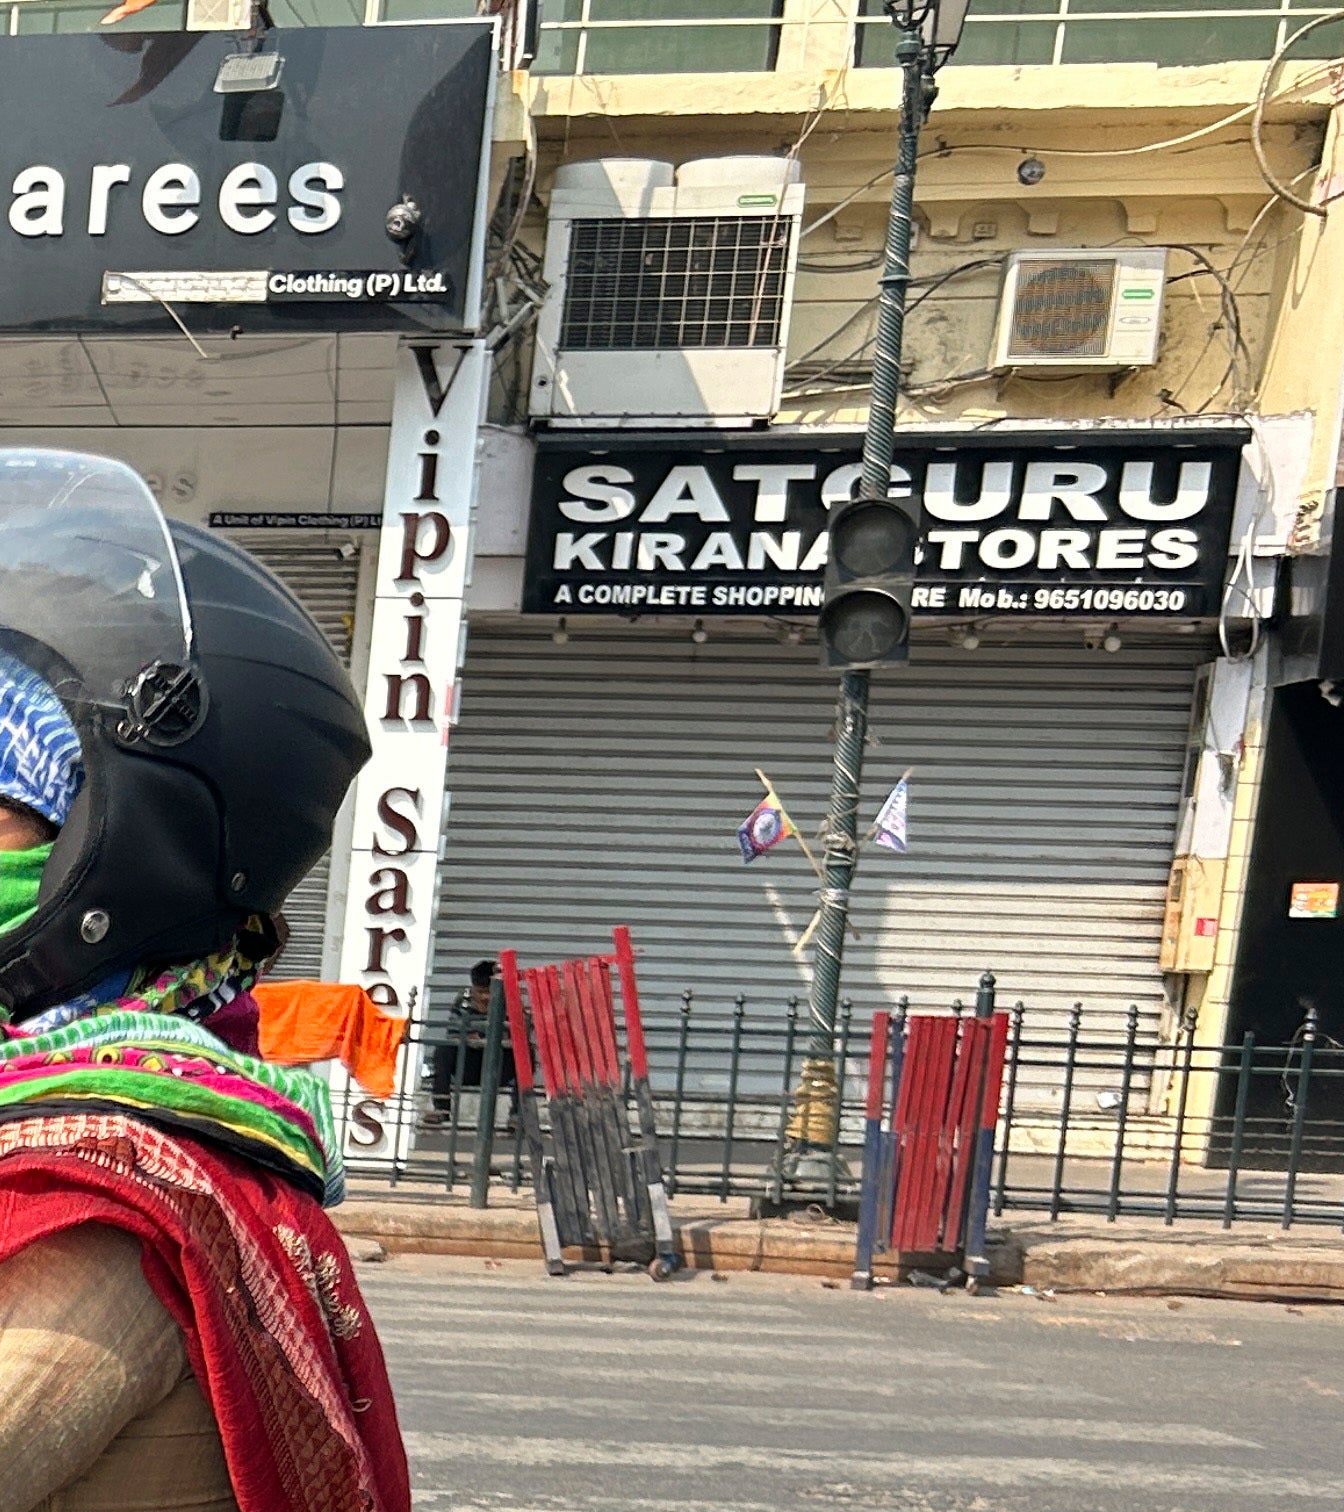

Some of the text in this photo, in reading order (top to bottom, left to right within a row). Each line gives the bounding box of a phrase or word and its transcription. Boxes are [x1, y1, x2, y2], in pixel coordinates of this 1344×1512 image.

[269, 273, 363, 298] Clothing
[365, 274, 400, 297] (P)
[404, 273, 448, 293] Ltd.
[913, 529, 1200, 570] TORES
[553, 585, 573, 604] A
[577, 584, 707, 605] COMPLETE
[712, 585, 826, 606] SHOPPIN
[1033, 589, 1186, 611] 9651096030
